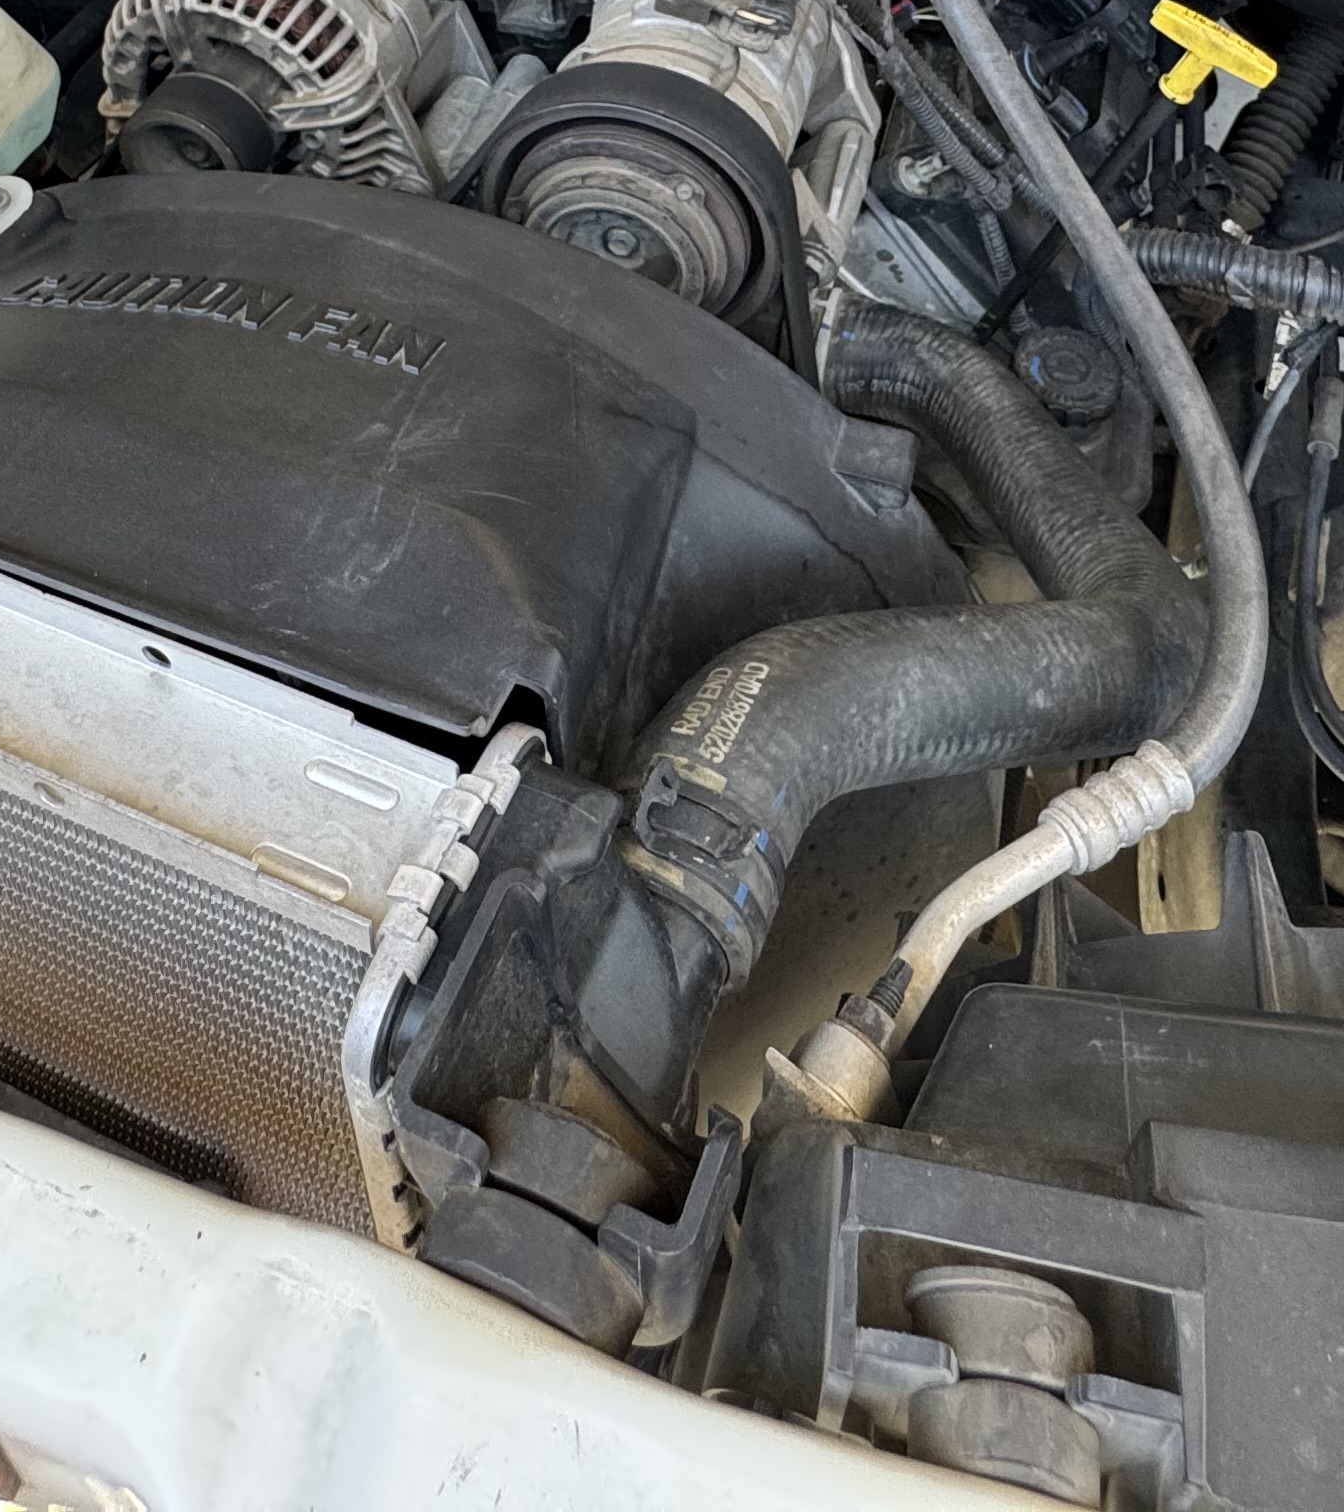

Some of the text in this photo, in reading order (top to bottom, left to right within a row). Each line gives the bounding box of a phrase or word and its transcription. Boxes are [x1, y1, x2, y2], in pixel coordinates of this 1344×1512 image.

[286, 301, 447, 376] FAN
[670, 667, 733, 736] RAD END
